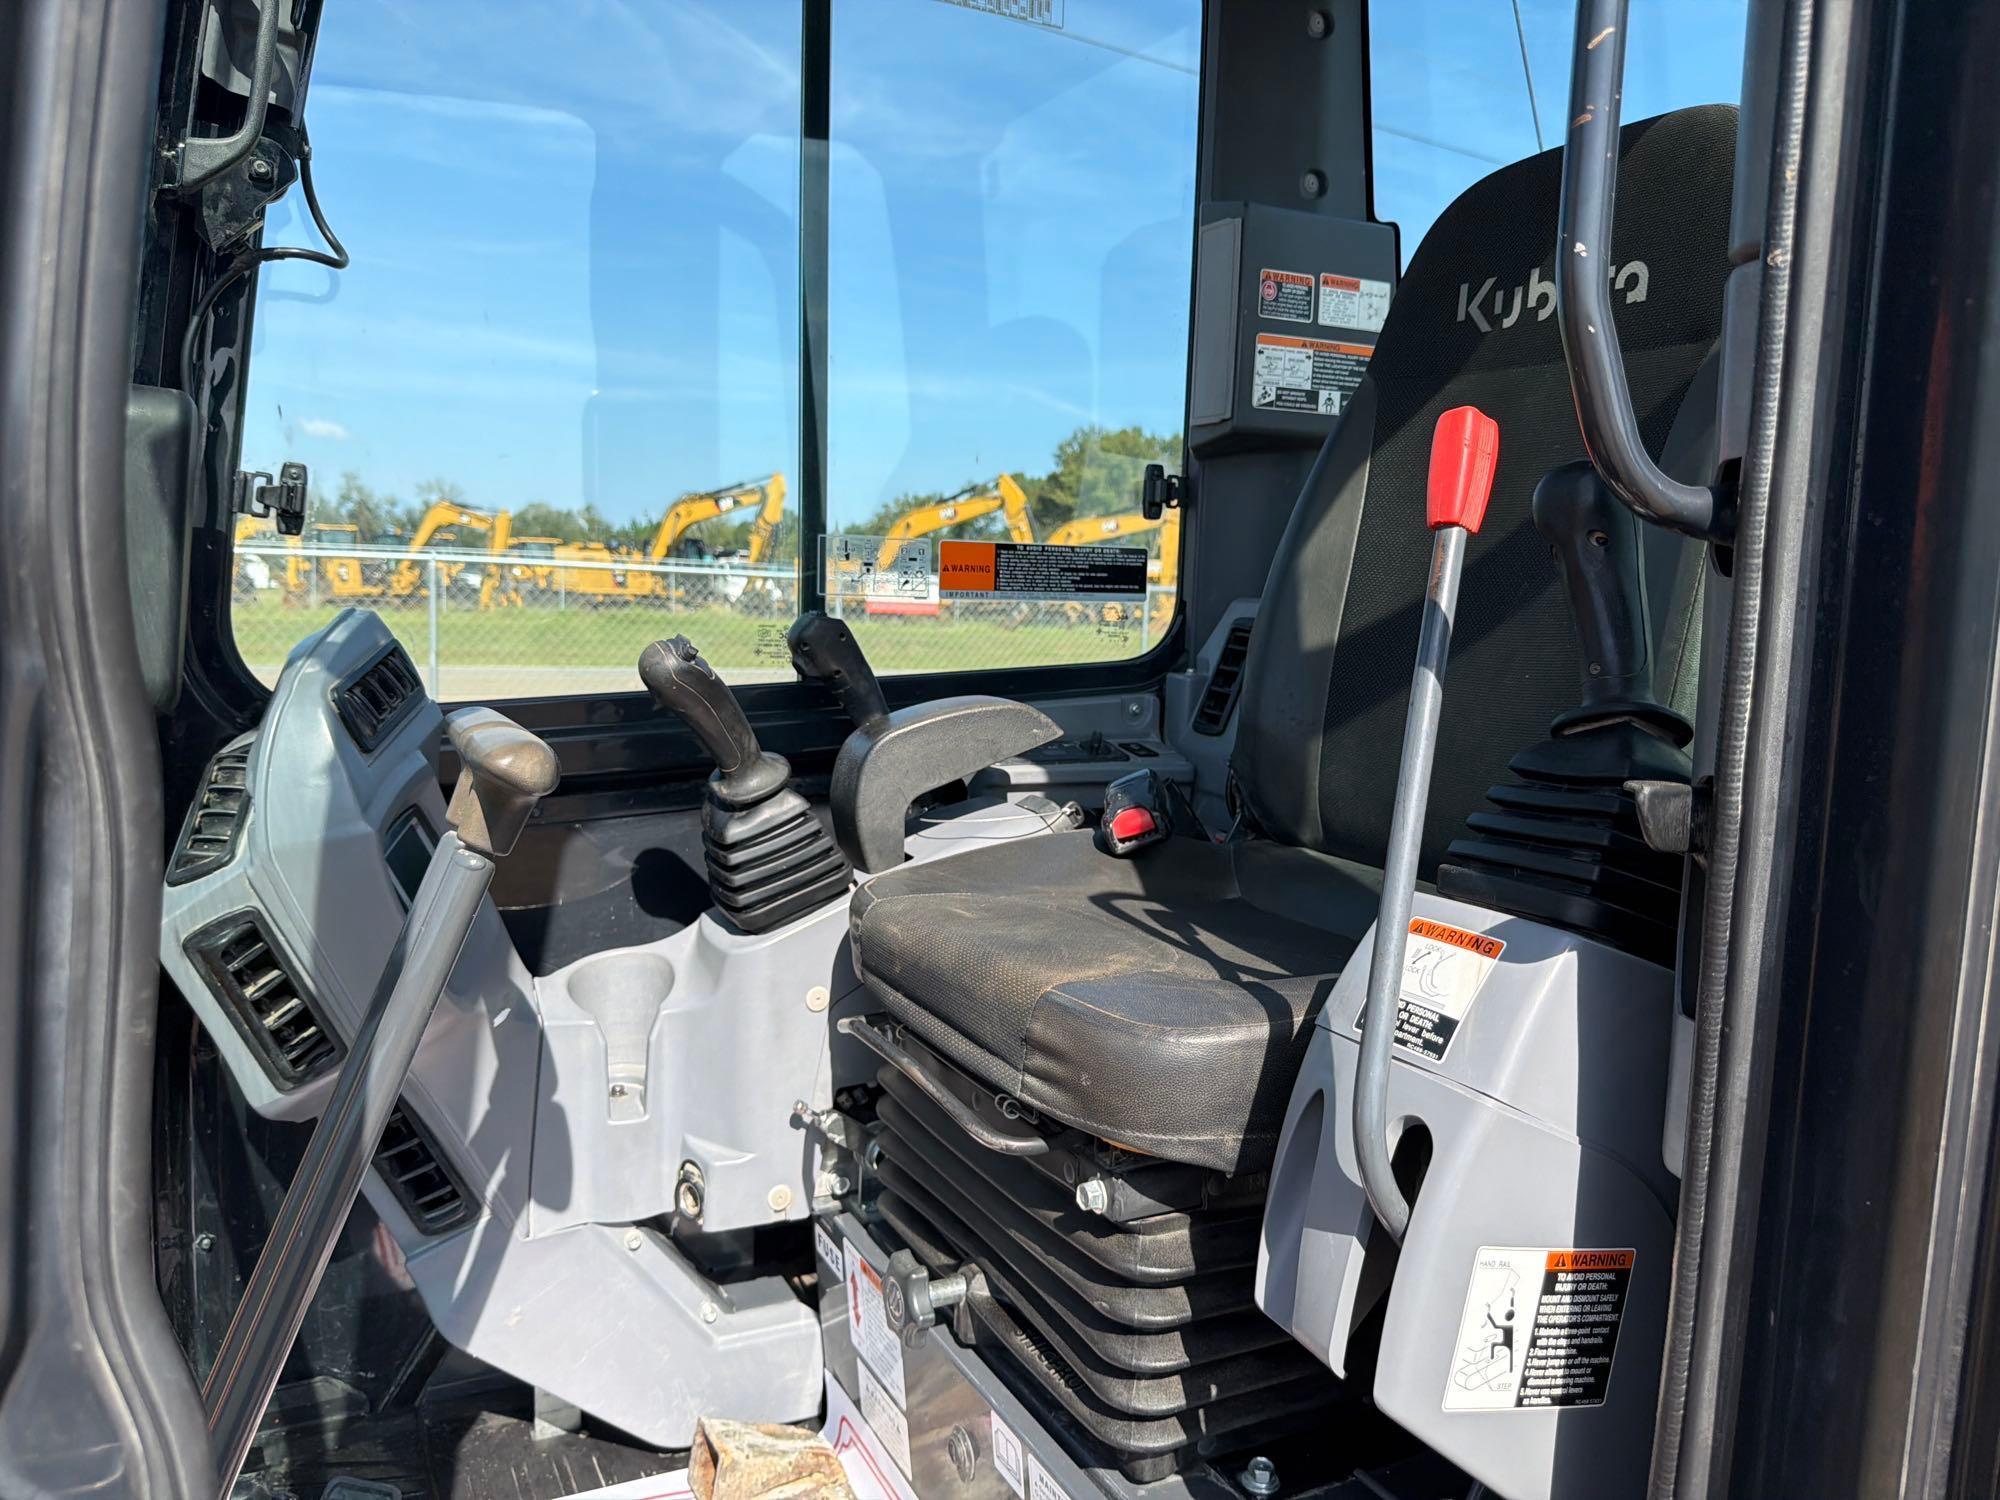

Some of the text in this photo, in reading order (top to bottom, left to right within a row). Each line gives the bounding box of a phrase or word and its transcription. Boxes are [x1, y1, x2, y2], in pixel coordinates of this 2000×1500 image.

[1272, 272, 1312, 286] WARNING
[1330, 279, 1360, 291] WARNING
[1456, 260, 1649, 333] Kuba
[1309, 342, 1341, 351] WARNING
[951, 564, 991, 574] WARNING
[945, 591, 989, 599] IMPORTANT
[1426, 923, 1495, 955] WARNING
[1406, 1003, 1440, 1023] PERSONAL
[1398, 1012, 1409, 1021] OR
[1409, 1015, 1433, 1031] DEATH:
[1402, 1022, 1420, 1034] lever
[1421, 1029, 1444, 1044] before
[817, 1232, 841, 1273] FUSE
[1570, 1254, 1627, 1267] WARNING
[1557, 1272, 1616, 1281] TO AVOID PERSONAL
[1555, 1283, 1577, 1291] INJURY
[1541, 1295, 1561, 1303] MOUNT
[1561, 1295, 1573, 1303] AND
[1600, 1294, 1619, 1302] SAFELY
[1556, 1305, 1582, 1313] ENTERING
[1591, 1304, 1612, 1312] LEAVING
[1537, 1315, 1549, 1323] THE
[1548, 1315, 1582, 1323] OPERATOR'S
